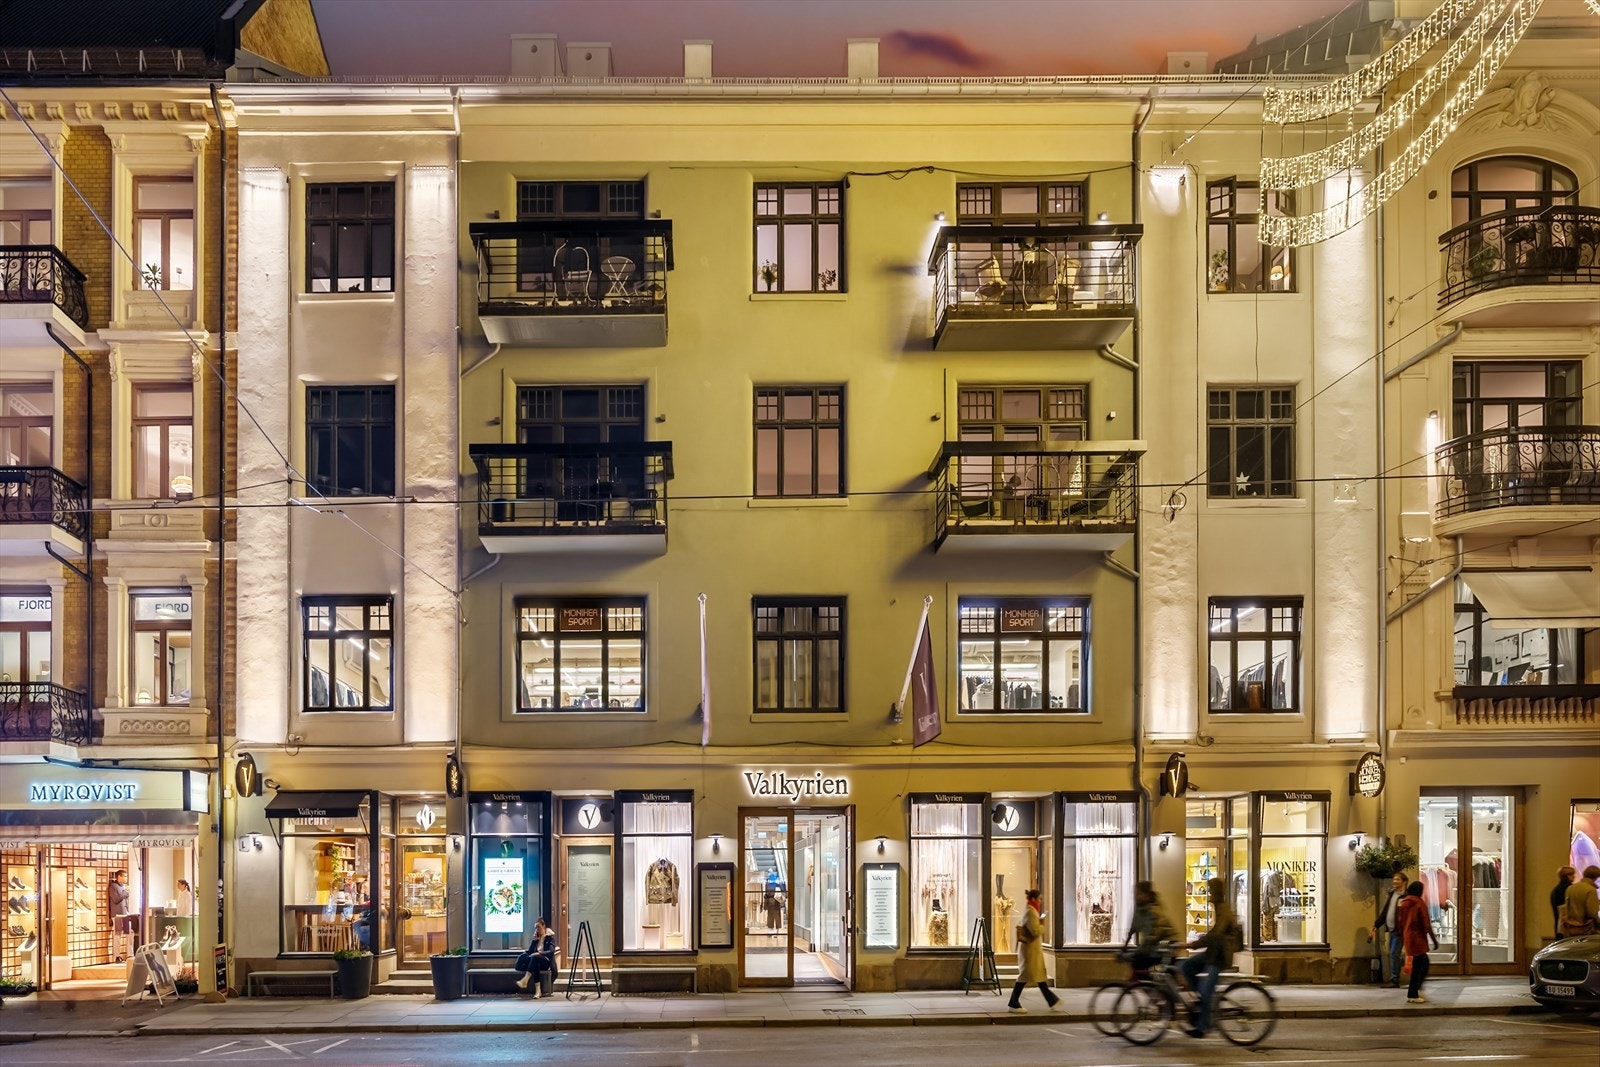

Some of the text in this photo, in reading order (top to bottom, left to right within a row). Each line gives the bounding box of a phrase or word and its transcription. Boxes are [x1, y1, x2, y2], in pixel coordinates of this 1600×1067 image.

[18, 600, 51, 610] FJORD
[563, 608, 598, 616] MONIKER
[1004, 610, 1040, 618] MONIKER
[568, 618, 594, 626] SPORT
[1009, 618, 1035, 626] SPORT
[744, 772, 848, 801] Valkyrien
[31, 784, 136, 800] MYRQVIST
[492, 794, 520, 802] Valkyrien
[642, 794, 670, 802] Valkyrien
[935, 794, 962, 803] Valkyrien
[1089, 794, 1116, 802] Valkyrien
[1284, 792, 1312, 801] Valkyrien
[298, 808, 326, 818] Valkyrien
[137, 838, 186, 846] MYRQVIST
[1267, 861, 1316, 872] MONIKER
